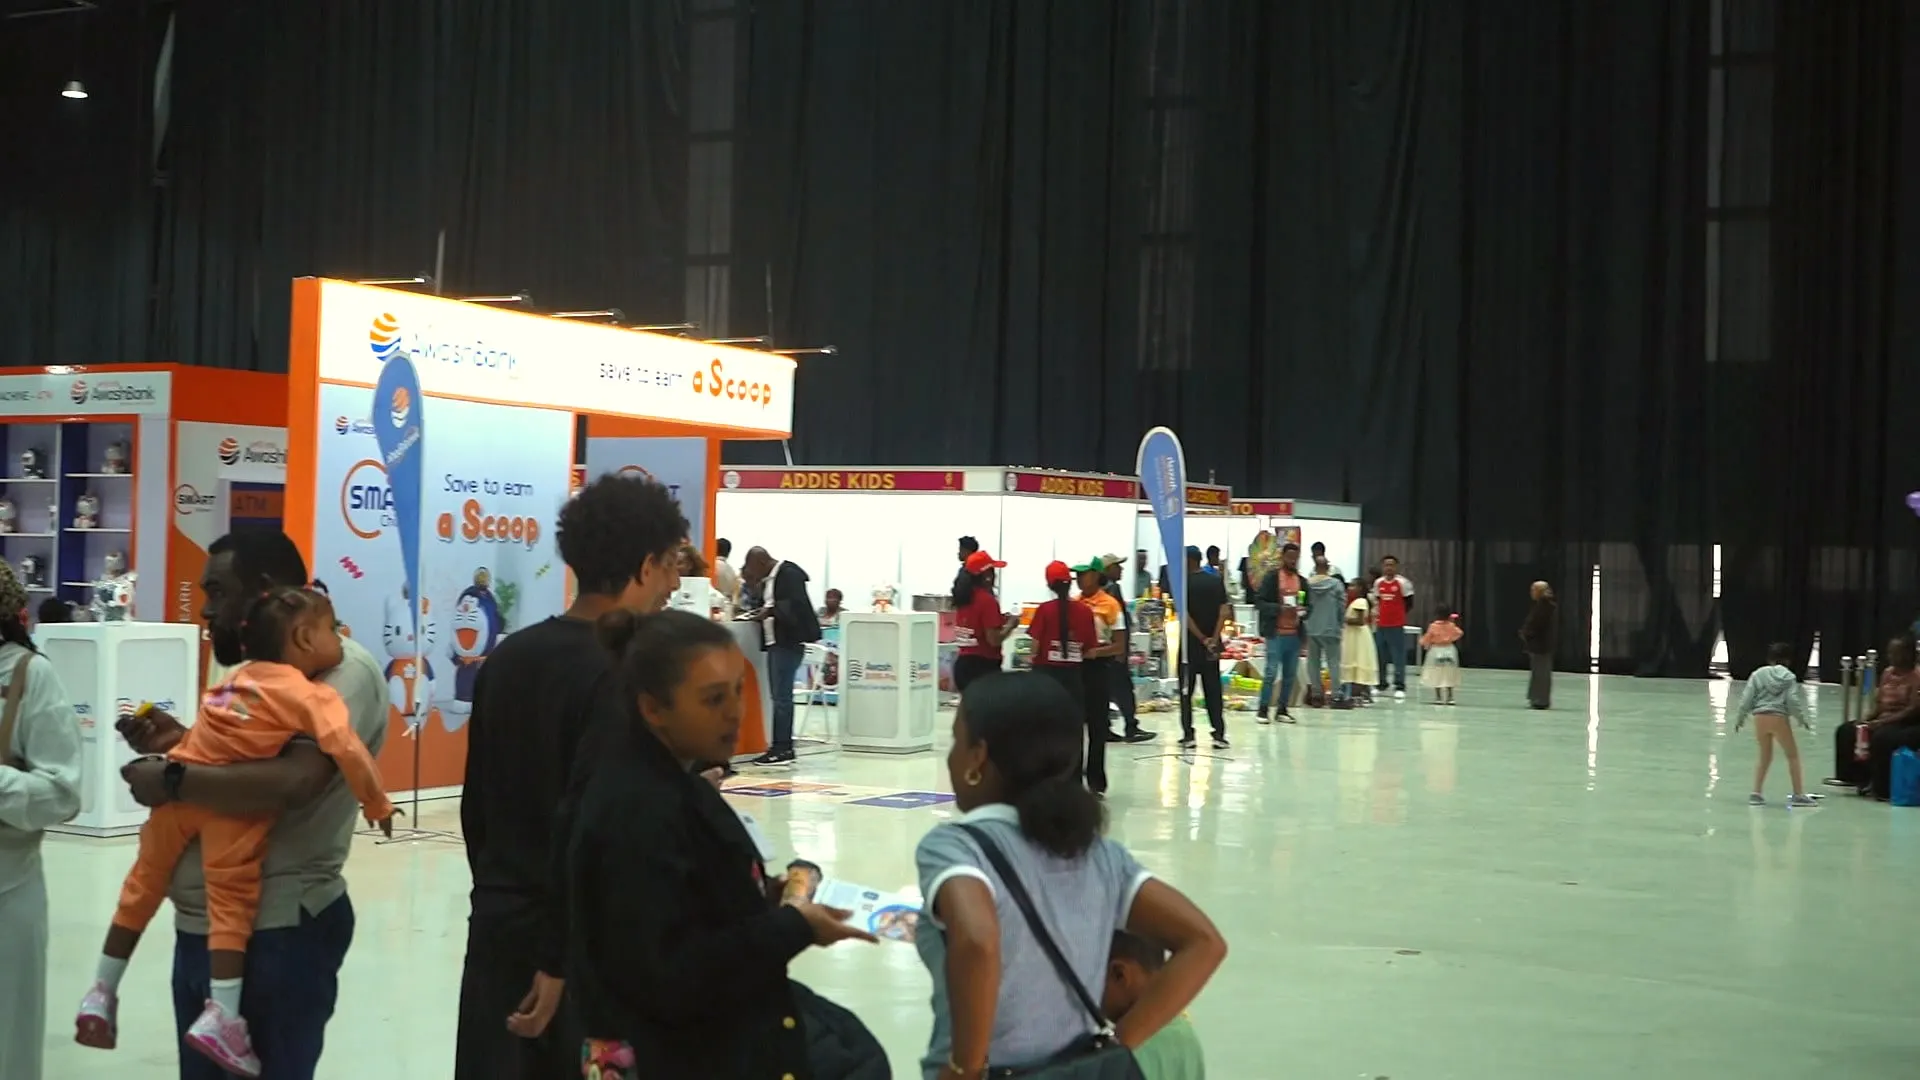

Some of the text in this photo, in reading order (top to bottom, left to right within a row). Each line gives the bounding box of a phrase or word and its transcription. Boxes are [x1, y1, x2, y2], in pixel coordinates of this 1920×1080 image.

[692, 371, 703, 394] a
[709, 358, 772, 409] Scoop
[444, 473, 533, 497] Save to earn
[780, 472, 895, 490] ADDIS KIDS
[437, 498, 540, 551] a Scoop
